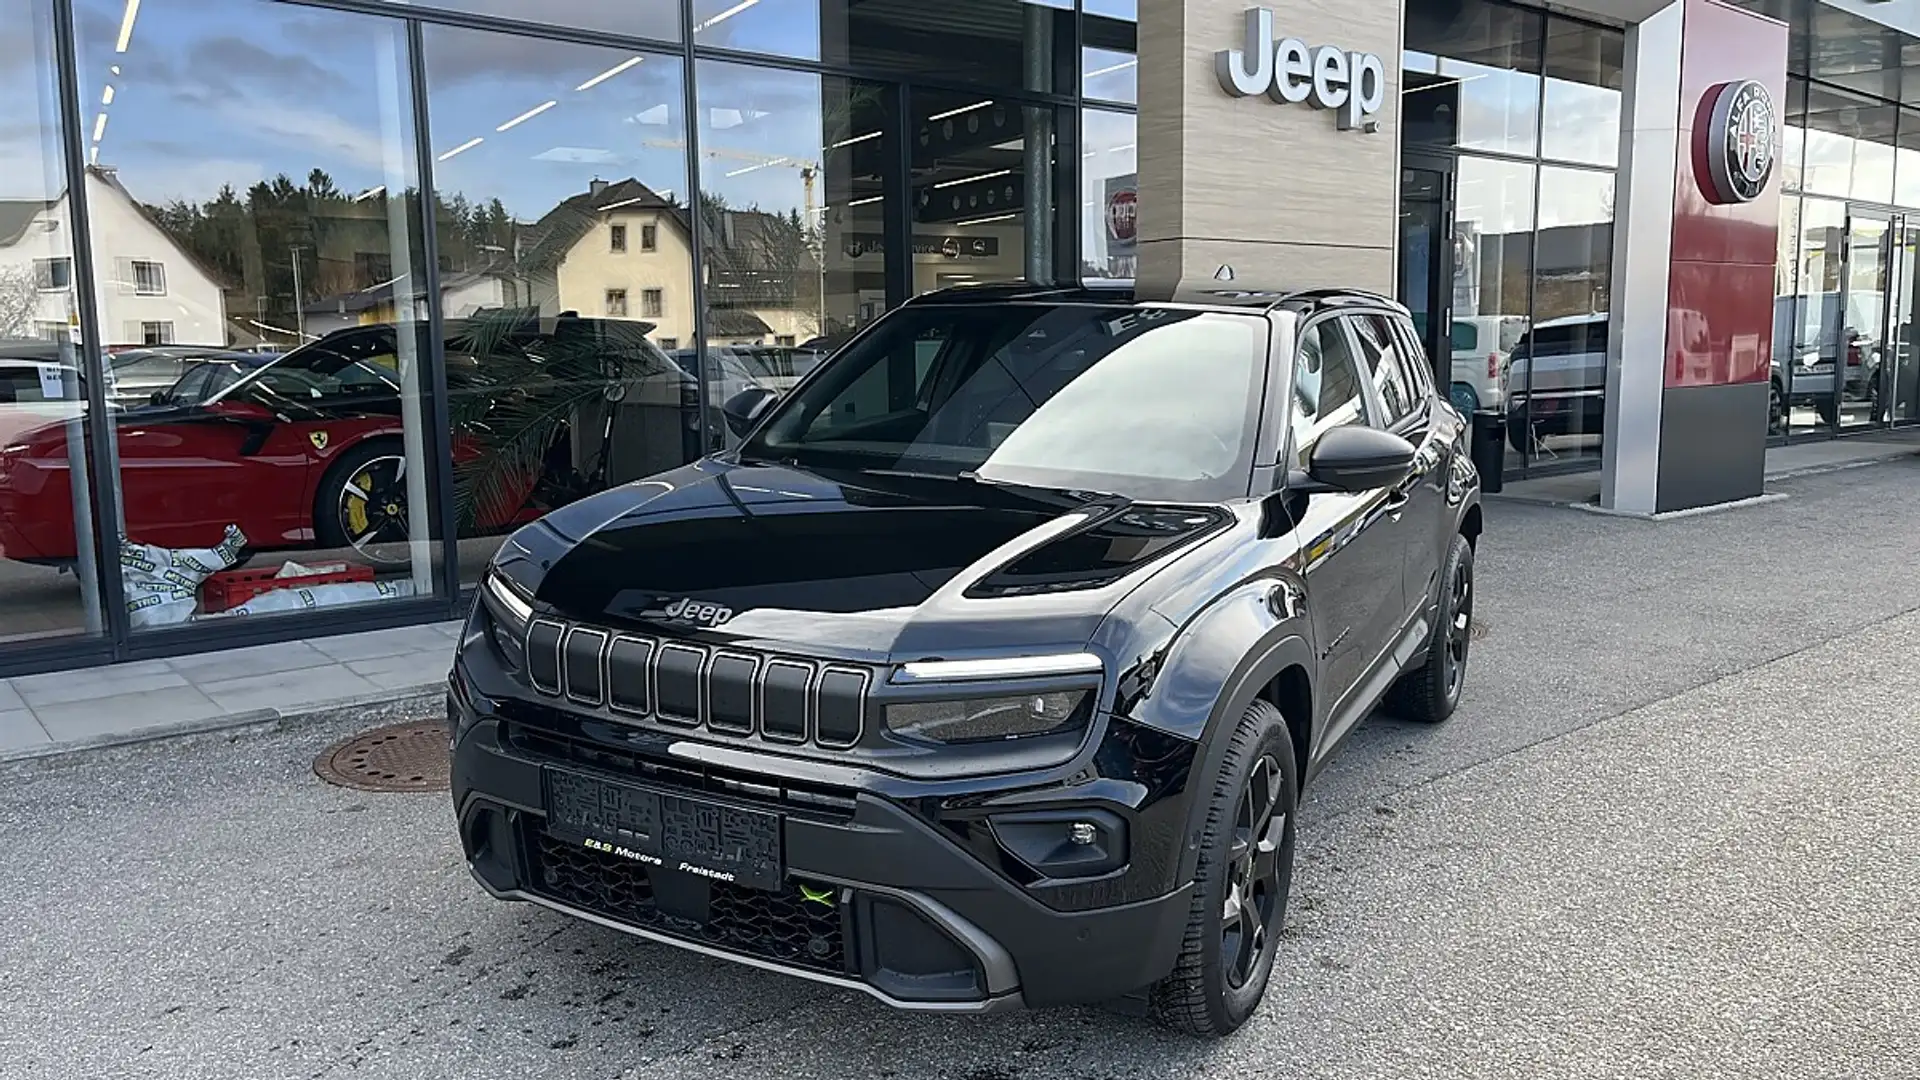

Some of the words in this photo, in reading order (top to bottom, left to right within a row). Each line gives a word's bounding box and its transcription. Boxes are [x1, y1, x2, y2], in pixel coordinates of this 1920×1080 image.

[1216, 7, 1384, 130] Jeep
[1729, 91, 1751, 138] ALFA
[665, 598, 732, 626] Jeep
[614, 846, 663, 866] Motors
[678, 862, 735, 881] Freistadt
